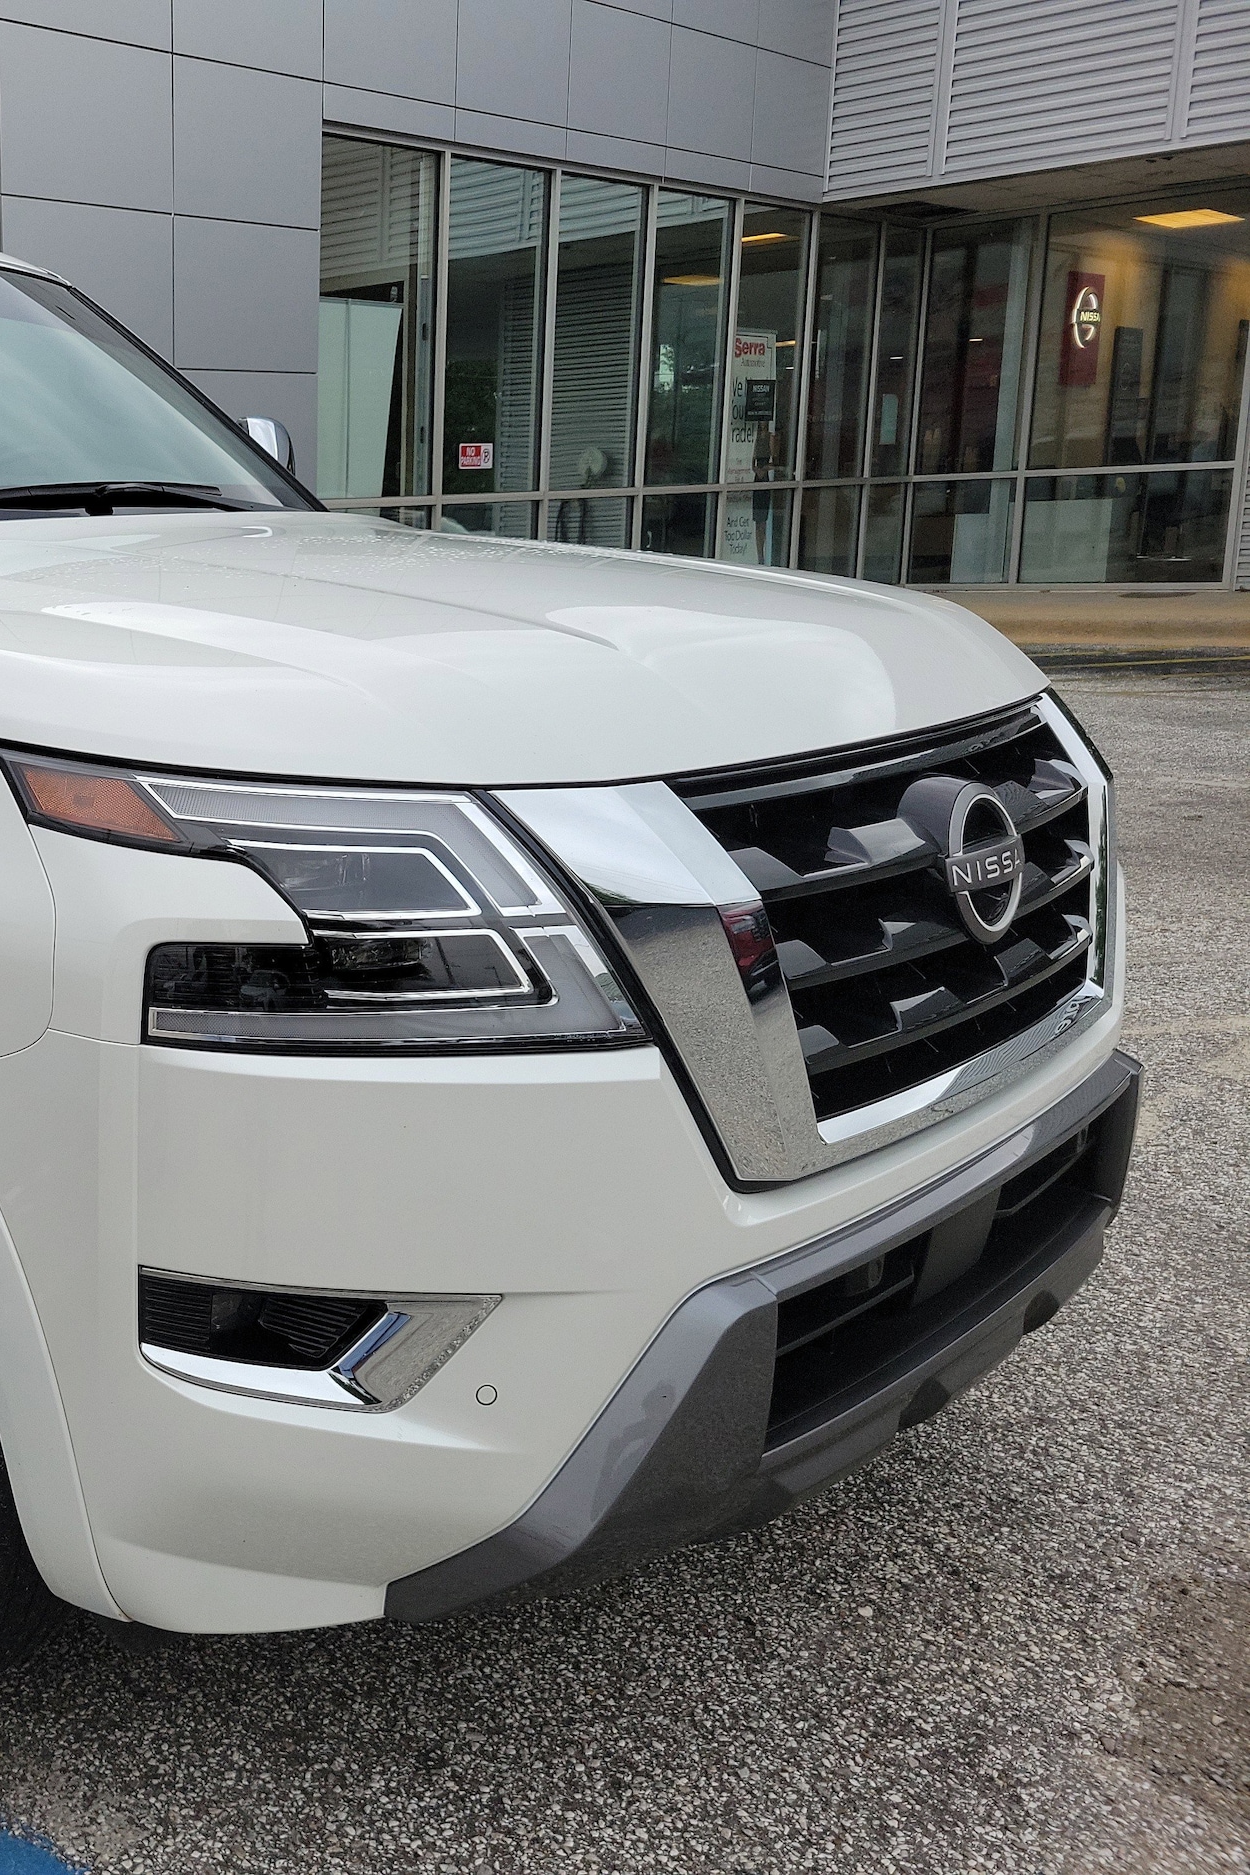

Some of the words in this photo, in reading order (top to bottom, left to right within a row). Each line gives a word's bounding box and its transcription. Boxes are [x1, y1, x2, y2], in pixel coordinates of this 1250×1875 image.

[1080, 311, 1100, 322] NISSA
[735, 338, 765, 358] Serra
[752, 385, 770, 393] NISSAN
[730, 421, 754, 443] rade!
[466, 446, 476, 456] NO
[461, 456, 480, 466] PARKING
[727, 516, 738, 527] And
[739, 516, 749, 527] Get
[724, 529, 734, 541] Top
[735, 529, 752, 541] Dollar
[952, 848, 1023, 886] NISSA
